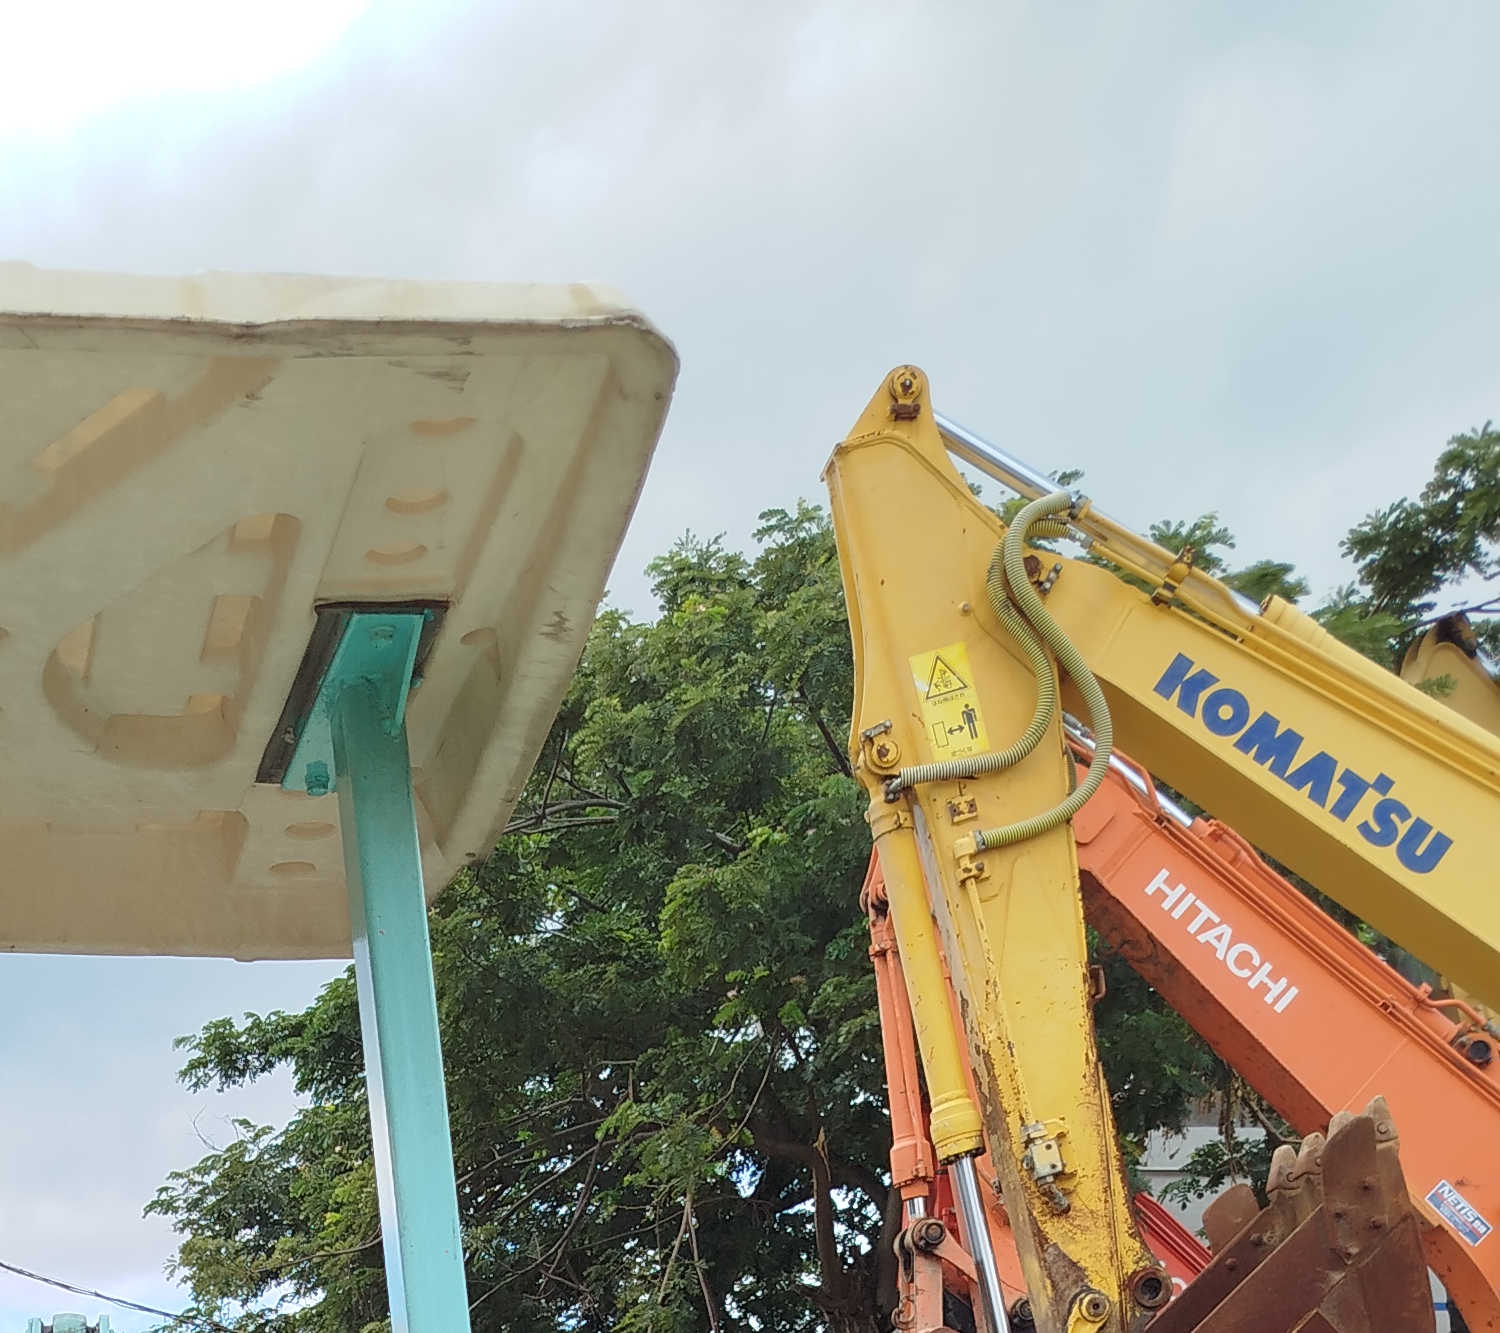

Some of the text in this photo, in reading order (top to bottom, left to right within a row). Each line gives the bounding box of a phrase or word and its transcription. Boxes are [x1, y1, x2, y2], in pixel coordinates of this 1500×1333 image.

[1154, 652, 1455, 875] KOMATSU
[1144, 869, 1299, 1015] HITACHI
[1438, 1186, 1479, 1223] NETIS
